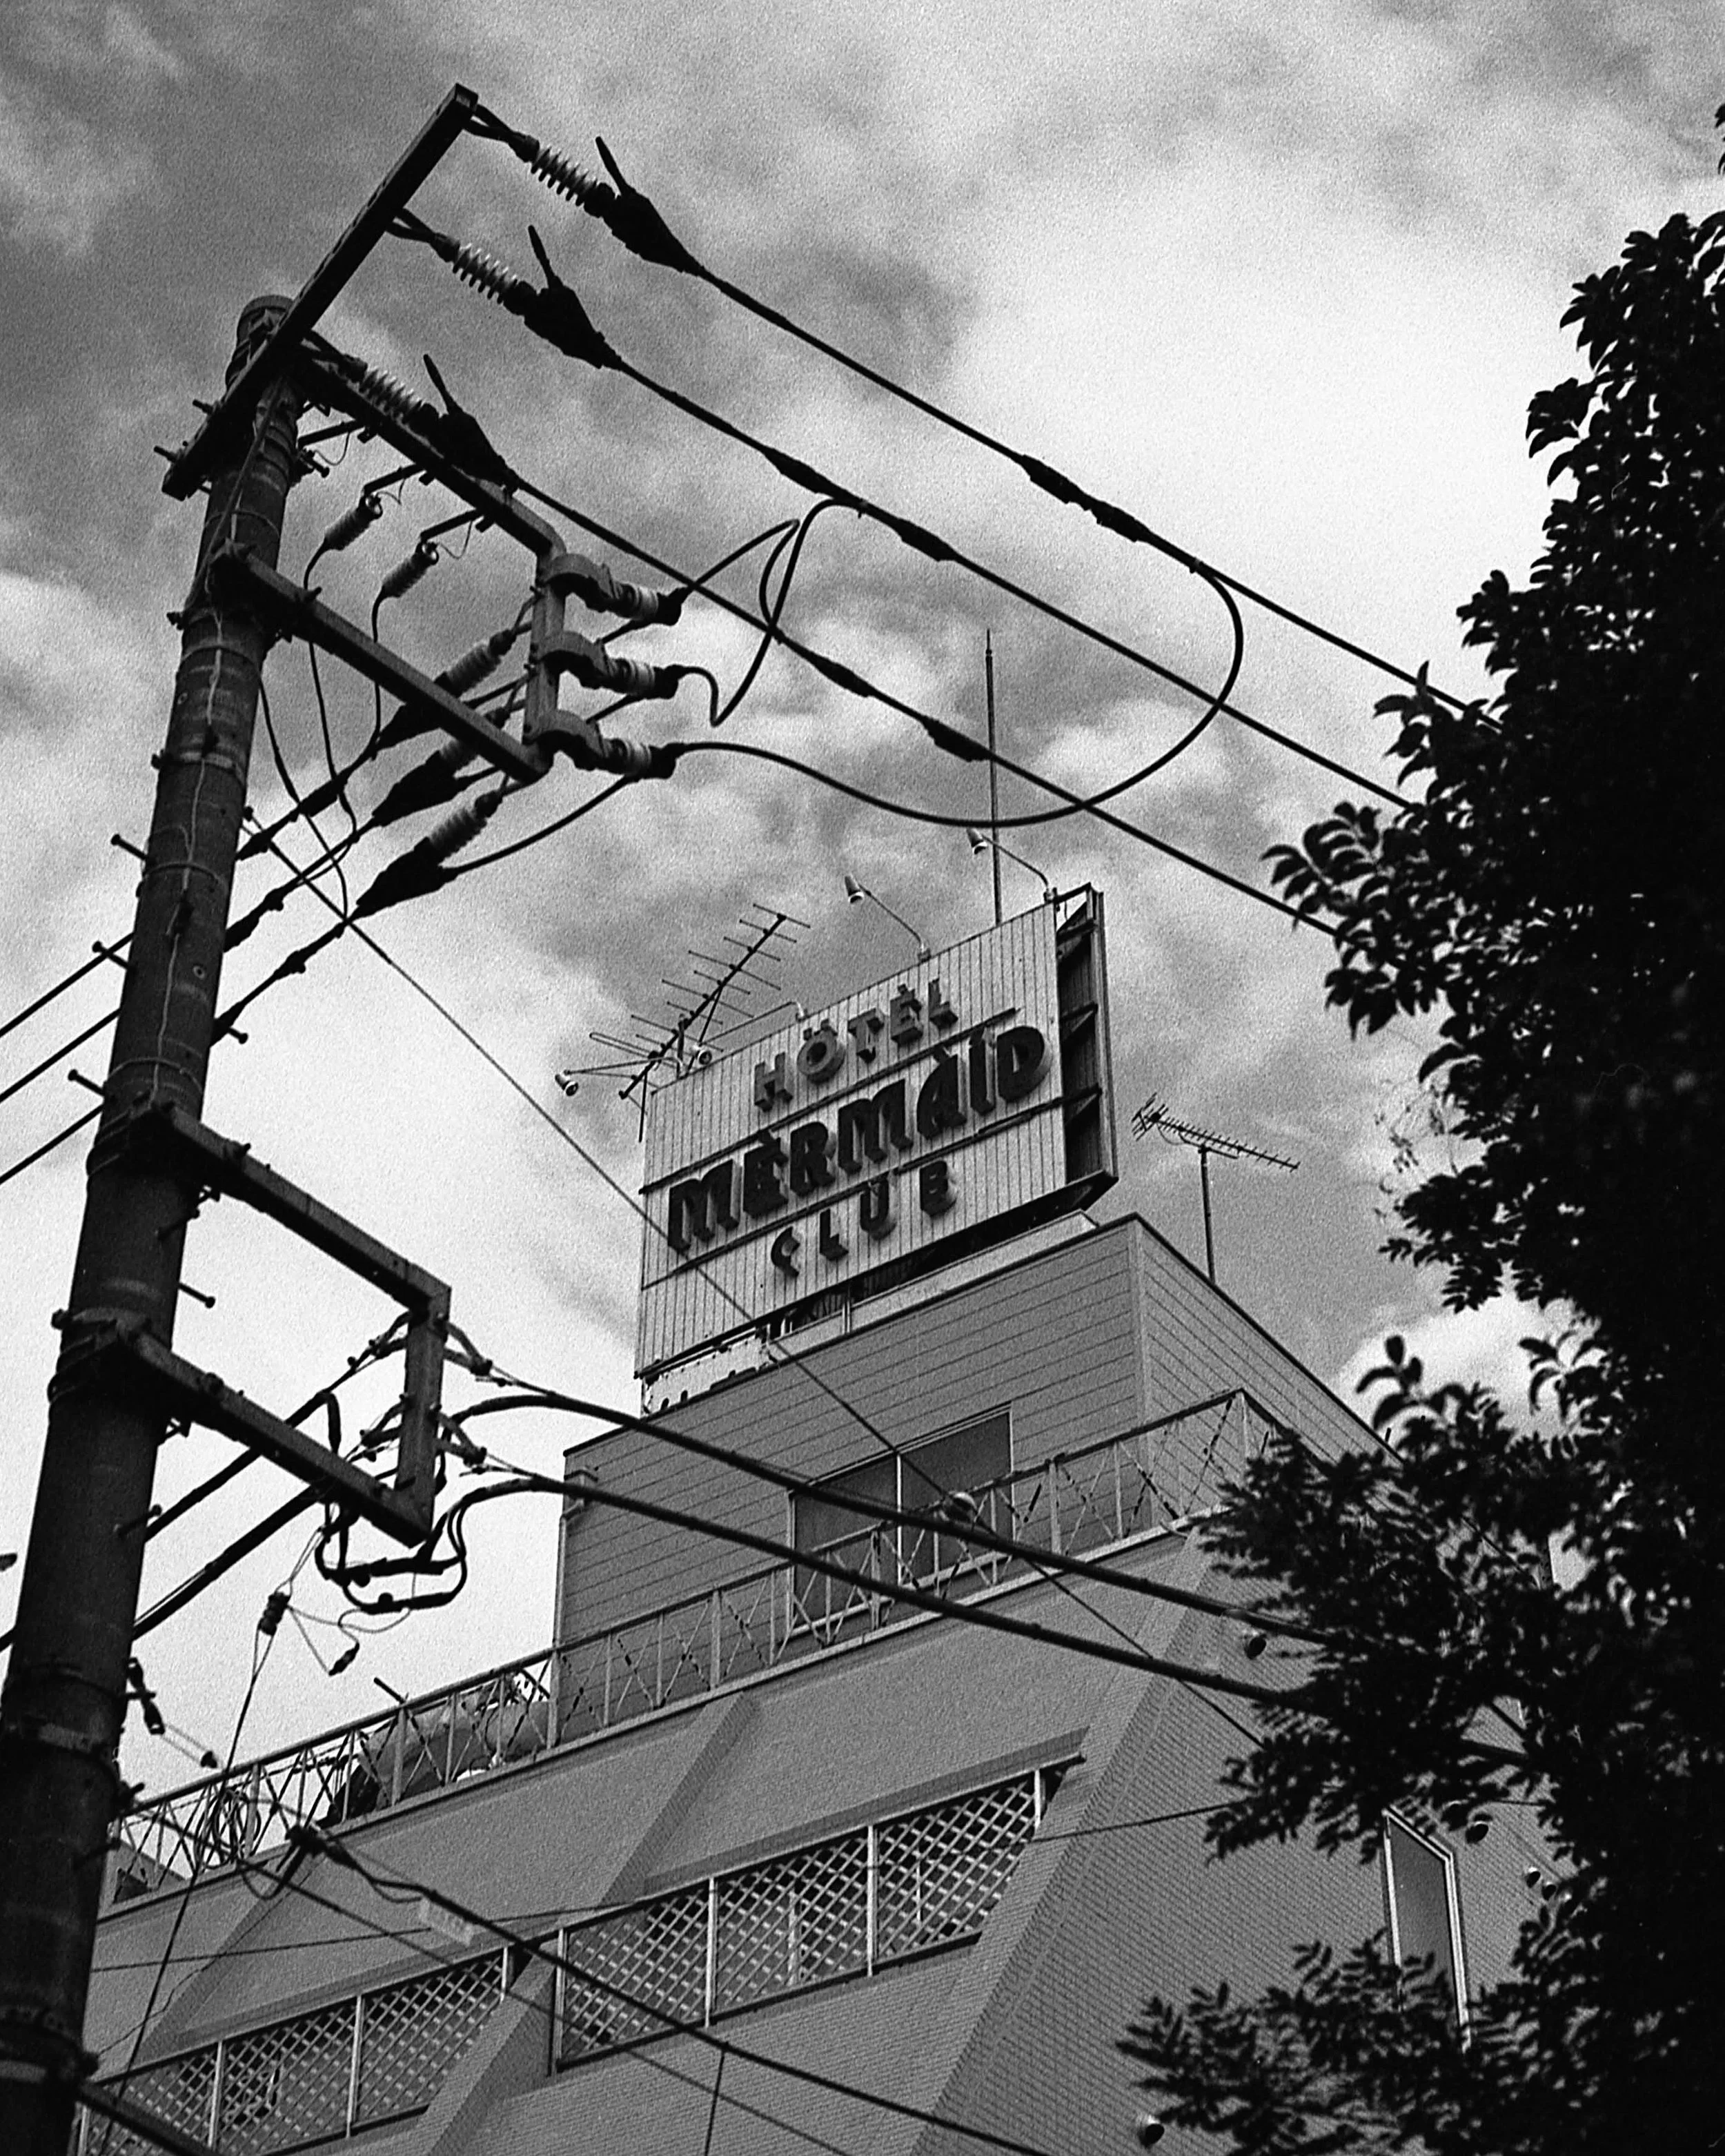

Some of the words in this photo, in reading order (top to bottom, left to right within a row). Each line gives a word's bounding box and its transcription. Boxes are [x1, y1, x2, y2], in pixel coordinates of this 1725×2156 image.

[754, 978, 959, 1113] HOTEL
[667, 1026, 1049, 1253] MERMAID
[770, 1160, 957, 1278] CLUB
